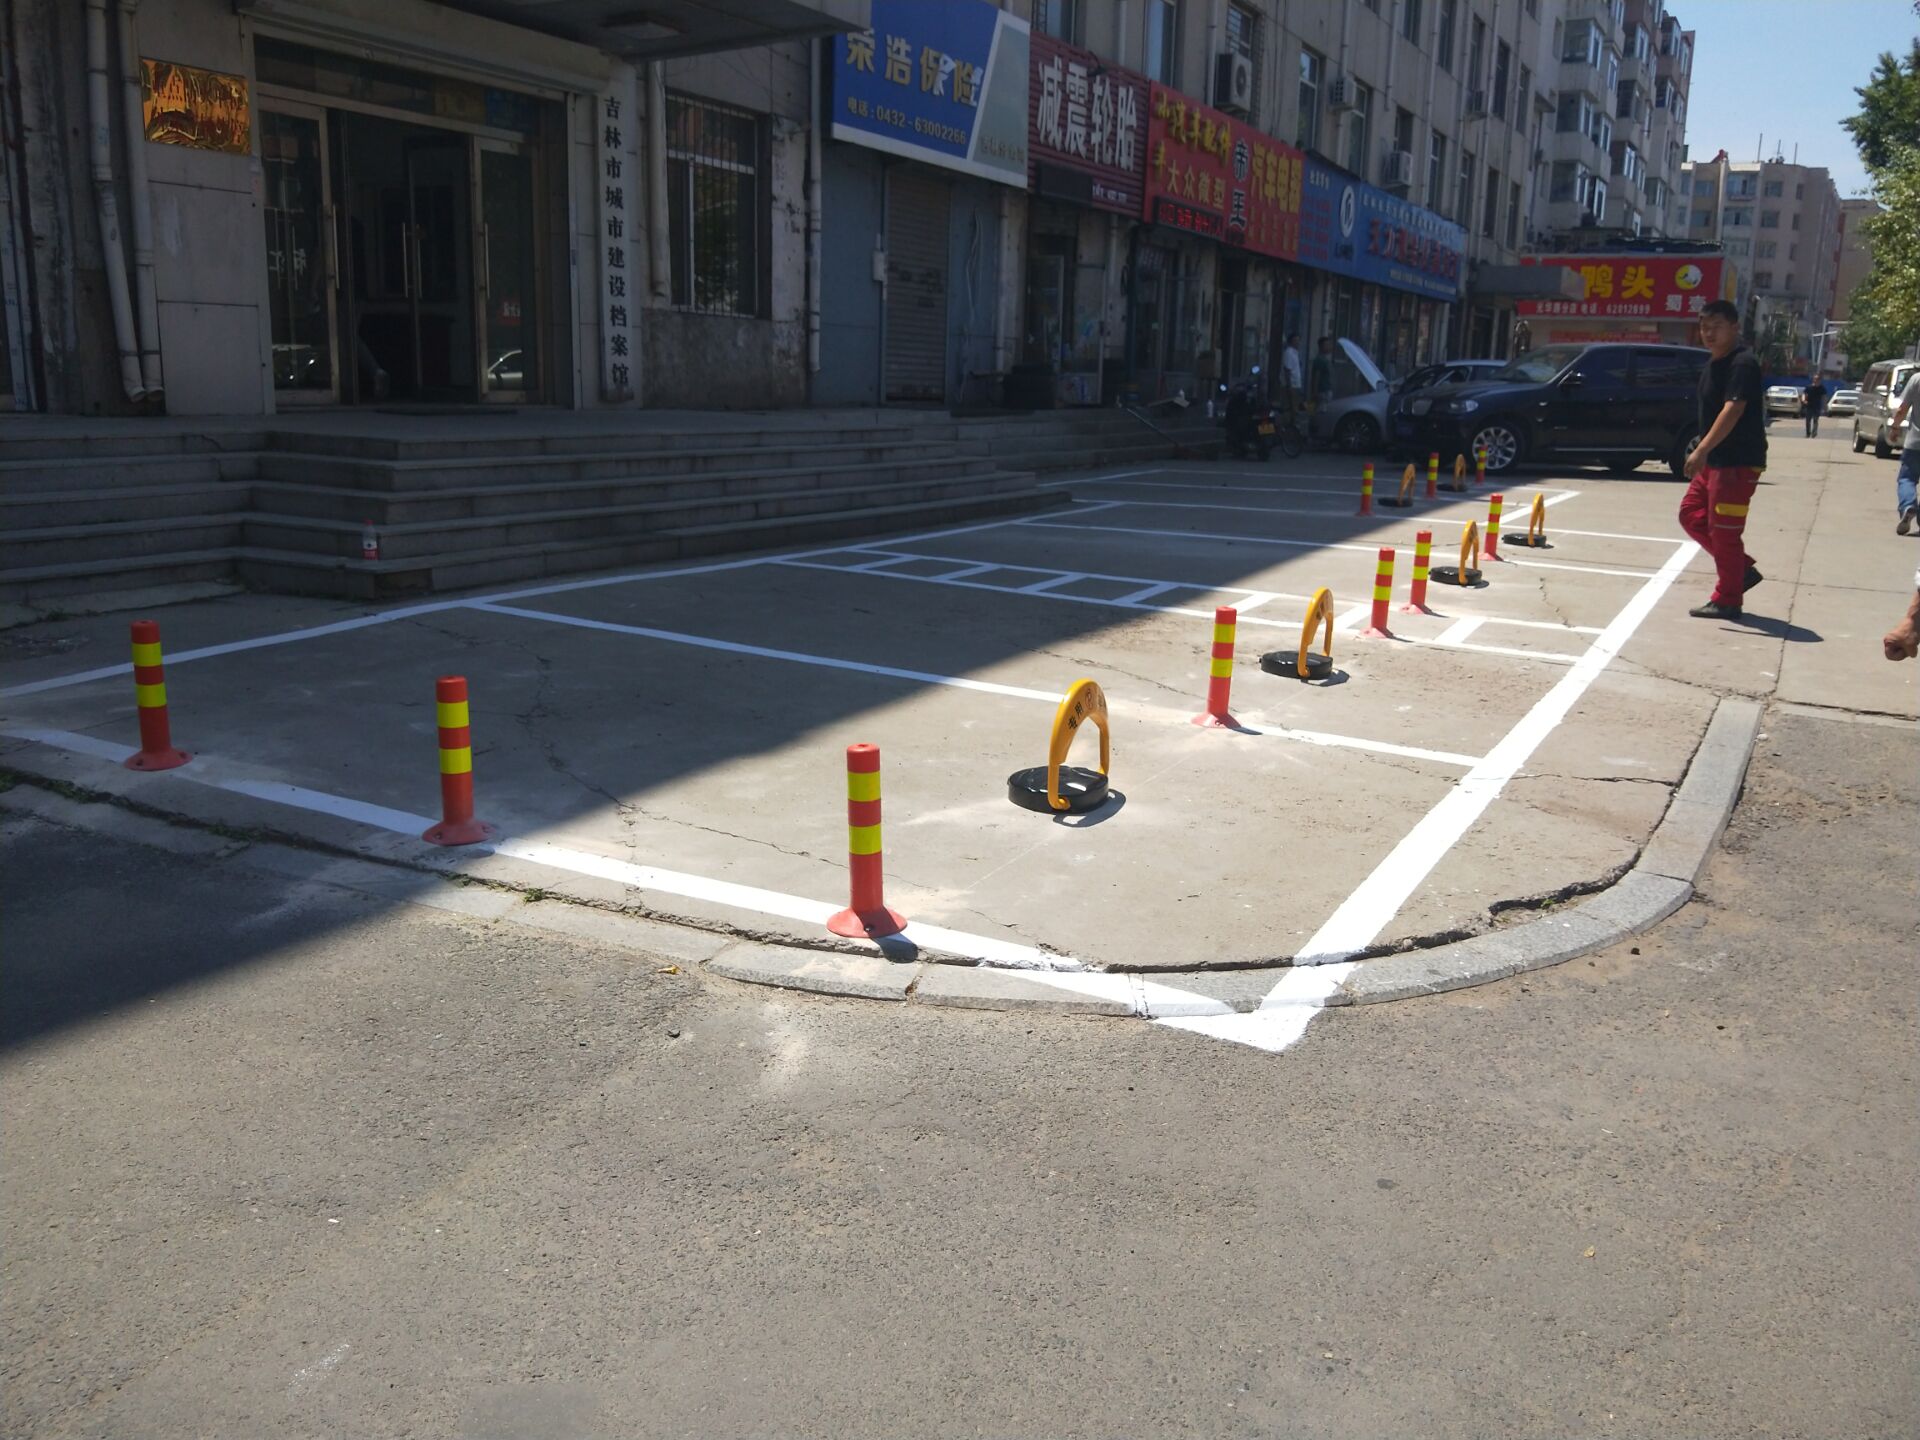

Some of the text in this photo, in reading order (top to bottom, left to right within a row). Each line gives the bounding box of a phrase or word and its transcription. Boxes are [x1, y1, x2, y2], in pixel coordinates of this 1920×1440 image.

[1036, 54, 1137, 172] 减震轮胎
[603, 96, 630, 388] 吉林市城市建设档案馆
